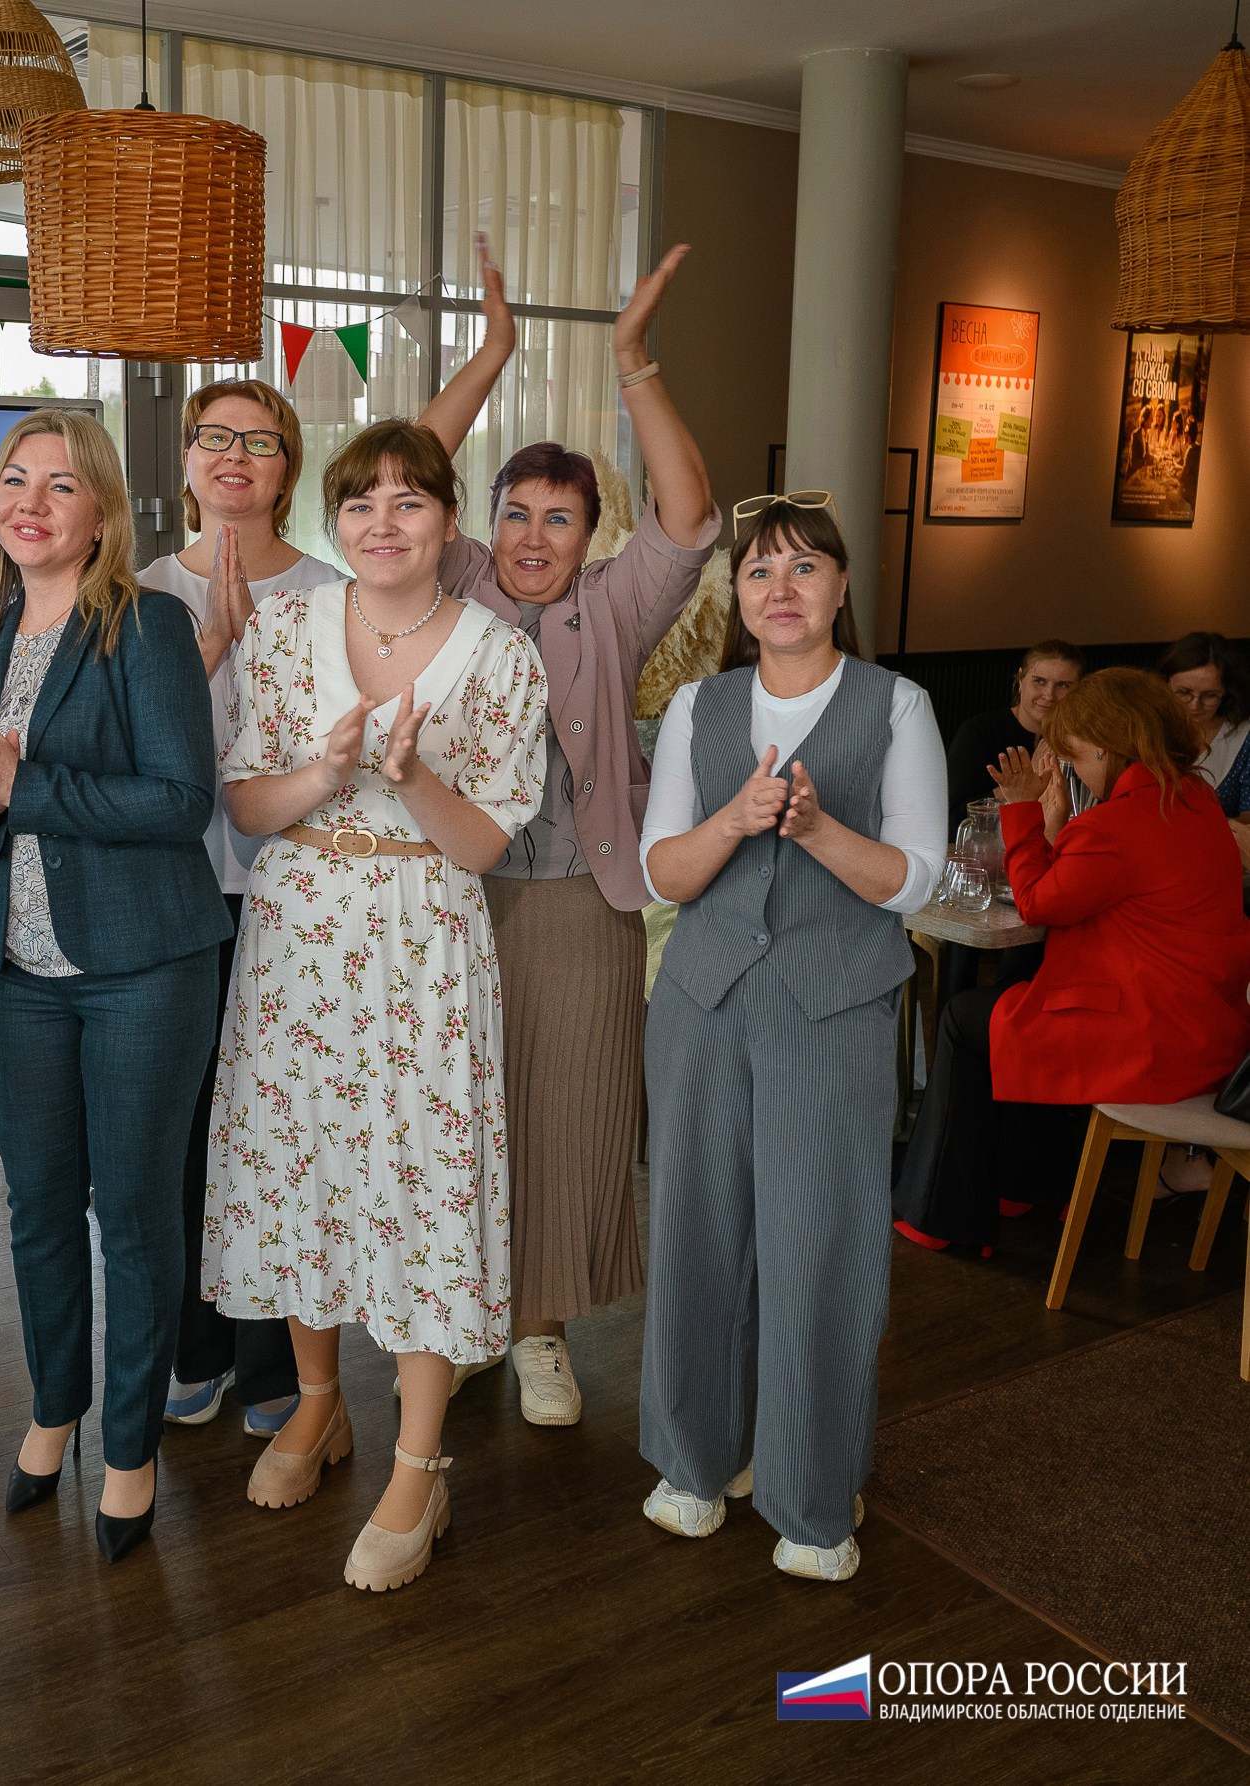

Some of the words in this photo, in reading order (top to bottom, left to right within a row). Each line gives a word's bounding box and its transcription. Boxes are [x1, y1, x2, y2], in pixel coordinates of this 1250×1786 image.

[951, 320, 988, 345] ВЕСНА
[1144, 342, 1165, 362] НАМ
[1134, 360, 1170, 381] МОЖНО
[1132, 379, 1145, 398] СО
[1145, 380, 1177, 401] СВОИМ
